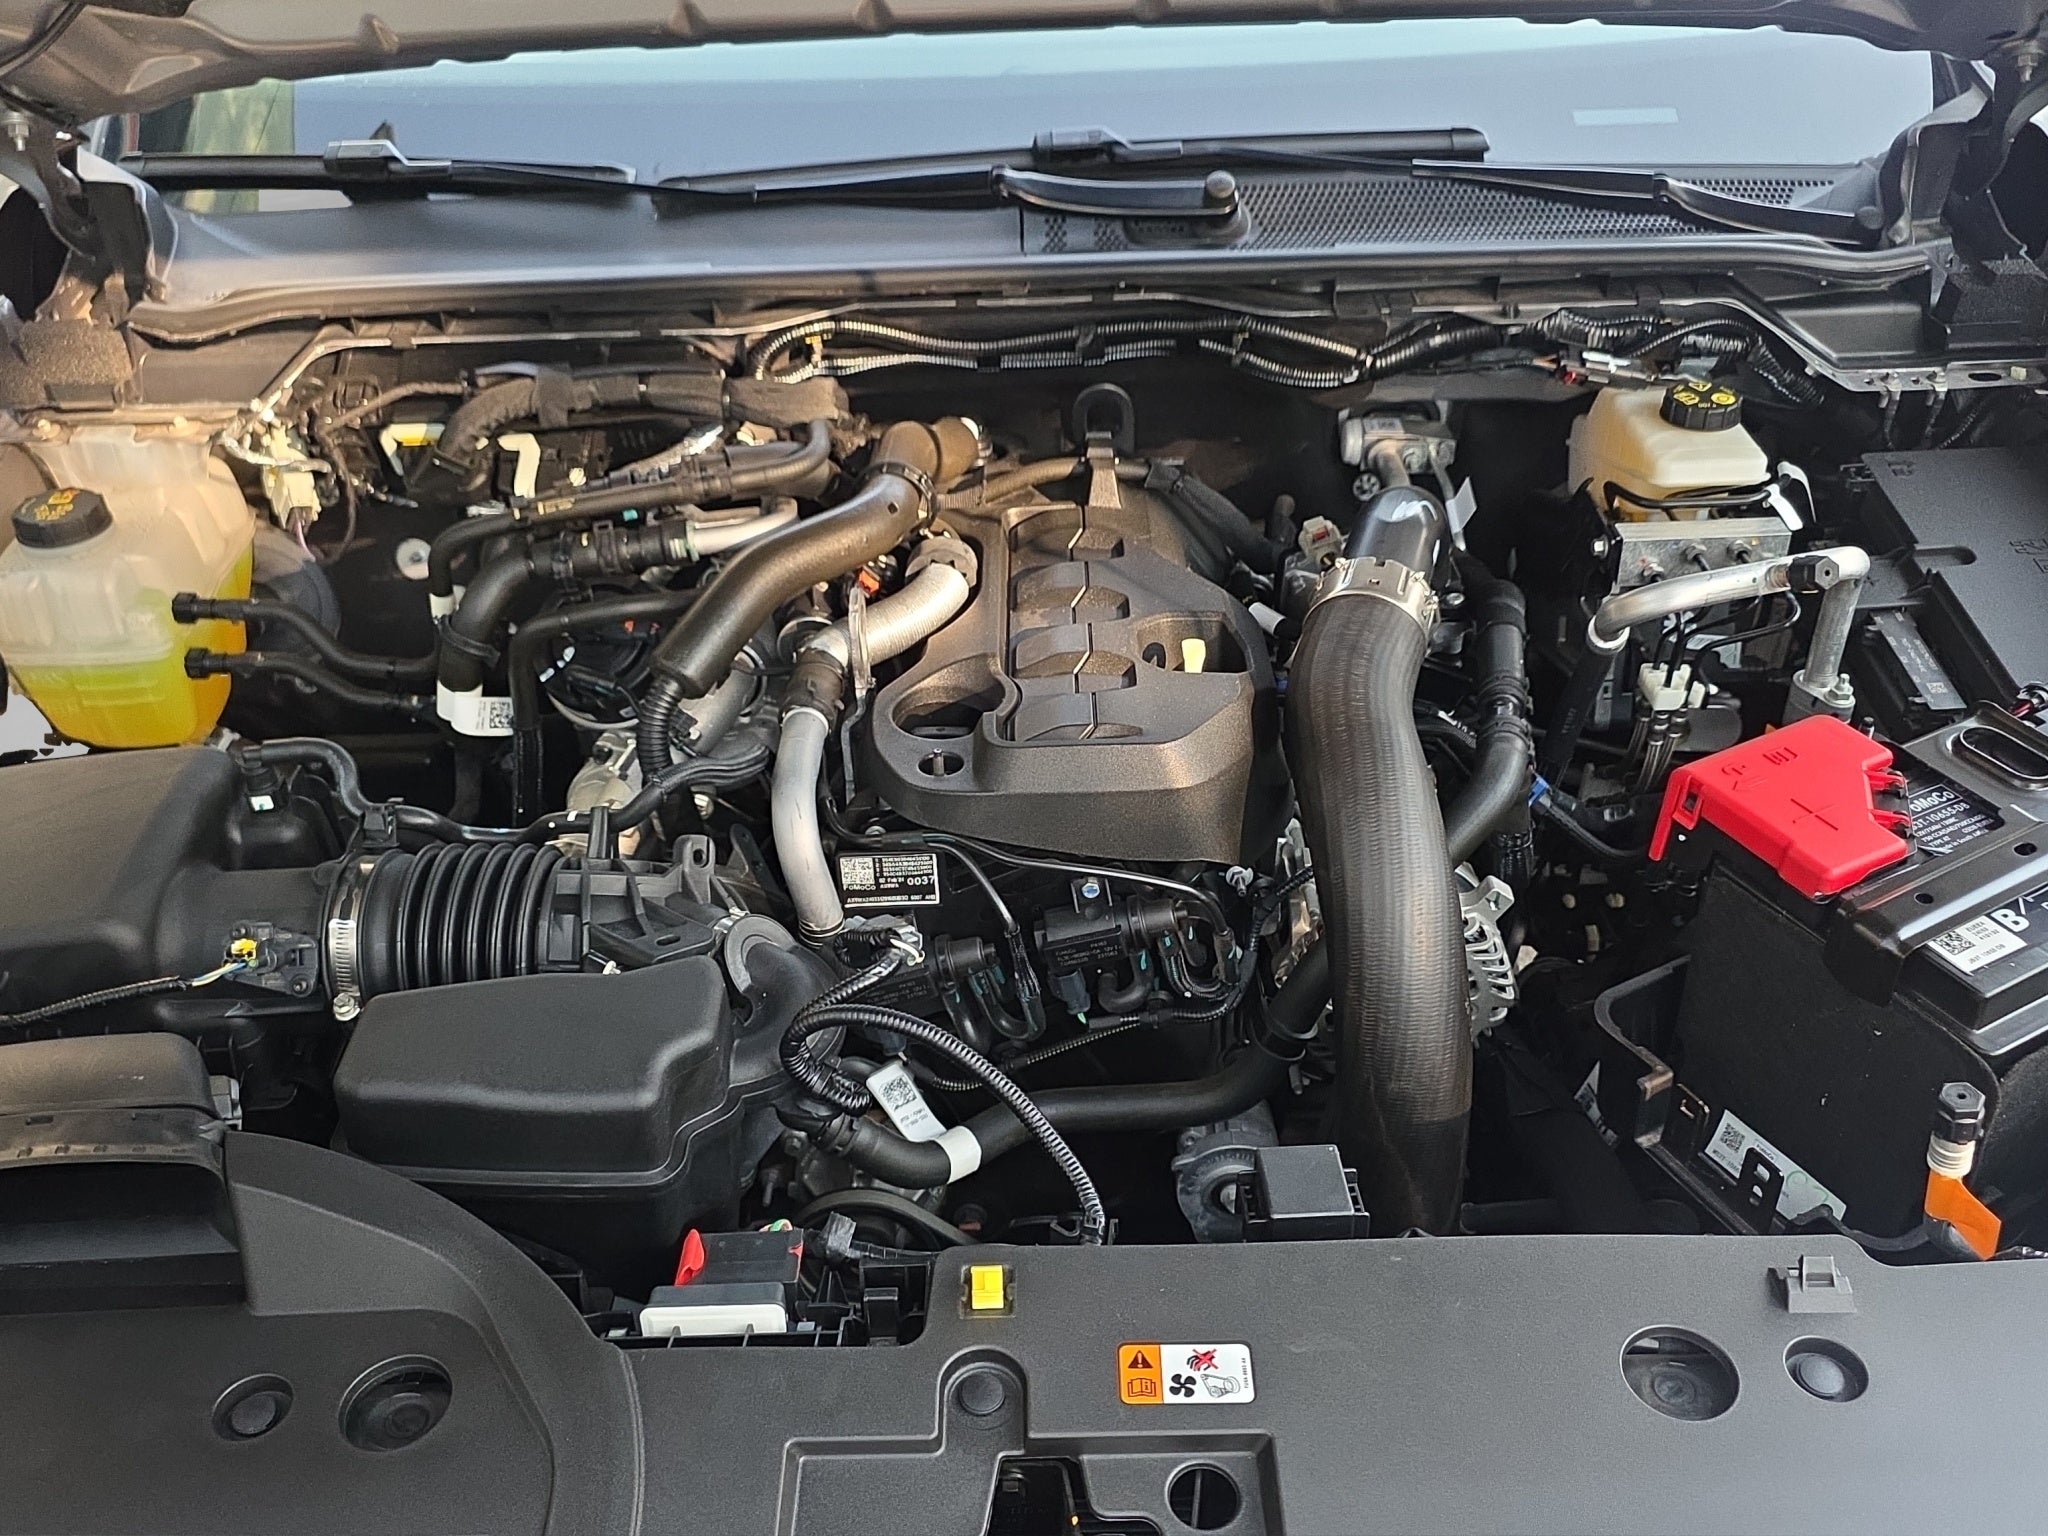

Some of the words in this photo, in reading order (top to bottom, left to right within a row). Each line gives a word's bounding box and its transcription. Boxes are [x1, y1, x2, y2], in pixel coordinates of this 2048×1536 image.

[1909, 791, 1955, 812] oMoCo
[1911, 802, 1970, 830] 3T-10655-DB
[842, 883, 876, 891] FoMoCo
[906, 875, 935, 886] 0037
